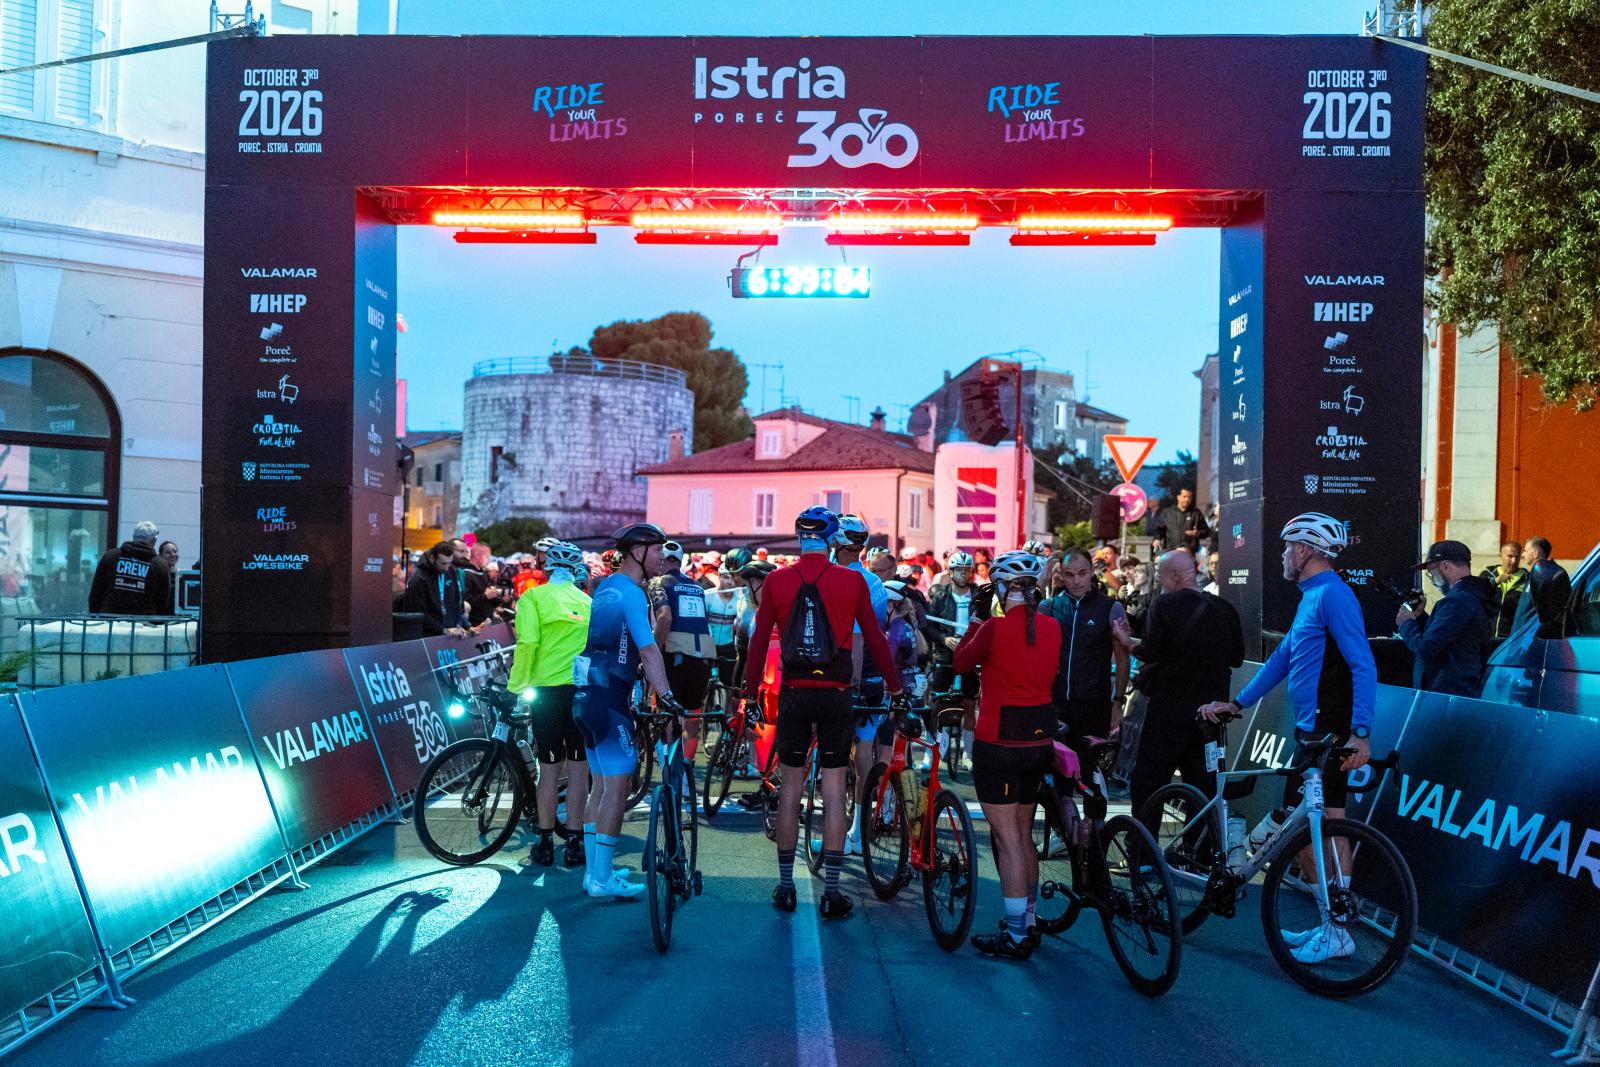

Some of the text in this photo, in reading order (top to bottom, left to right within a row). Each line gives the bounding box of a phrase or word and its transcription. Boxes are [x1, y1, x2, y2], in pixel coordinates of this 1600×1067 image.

[244, 68, 319, 86] OCTOBER 3RD
[694, 56, 846, 100] Istria
[1308, 70, 1387, 88] OCTOBER 3RD
[533, 82, 605, 118] RIDE
[987, 82, 1062, 117] RIDE
[238, 90, 323, 136] 2026
[694, 110, 784, 124] POREČ
[1302, 91, 1392, 139] 2026
[549, 117, 629, 143] LIMITS
[787, 108, 919, 169] 300
[1004, 117, 1086, 143] LIMITS
[267, 142, 289, 153] ISTRIA
[295, 142, 322, 153] CROATIA
[1332, 146, 1355, 157] ISTRIA
[1362, 146, 1391, 157] CROATIA
[241, 267, 318, 278] VALAMAR
[747, 265, 869, 295] 6:39:04
[1304, 275, 1385, 286] VALAMAR
[270, 293, 307, 313] HEP
[1334, 302, 1374, 322] HEP
[265, 345, 292, 355] Poreč
[1329, 355, 1357, 365] Poreč
[256, 389, 276, 398] Istra
[1320, 400, 1341, 410] Istra
[252, 422, 303, 435] CROATIA
[1315, 434, 1368, 447] CROATIA
[257, 506, 288, 522] RIDE
[263, 521, 297, 532] LIMITS
[253, 554, 310, 562] VALAMAR
[116, 560, 150, 577] CREW
[359, 660, 413, 705] Istria
[262, 710, 369, 770] VALAMAR
